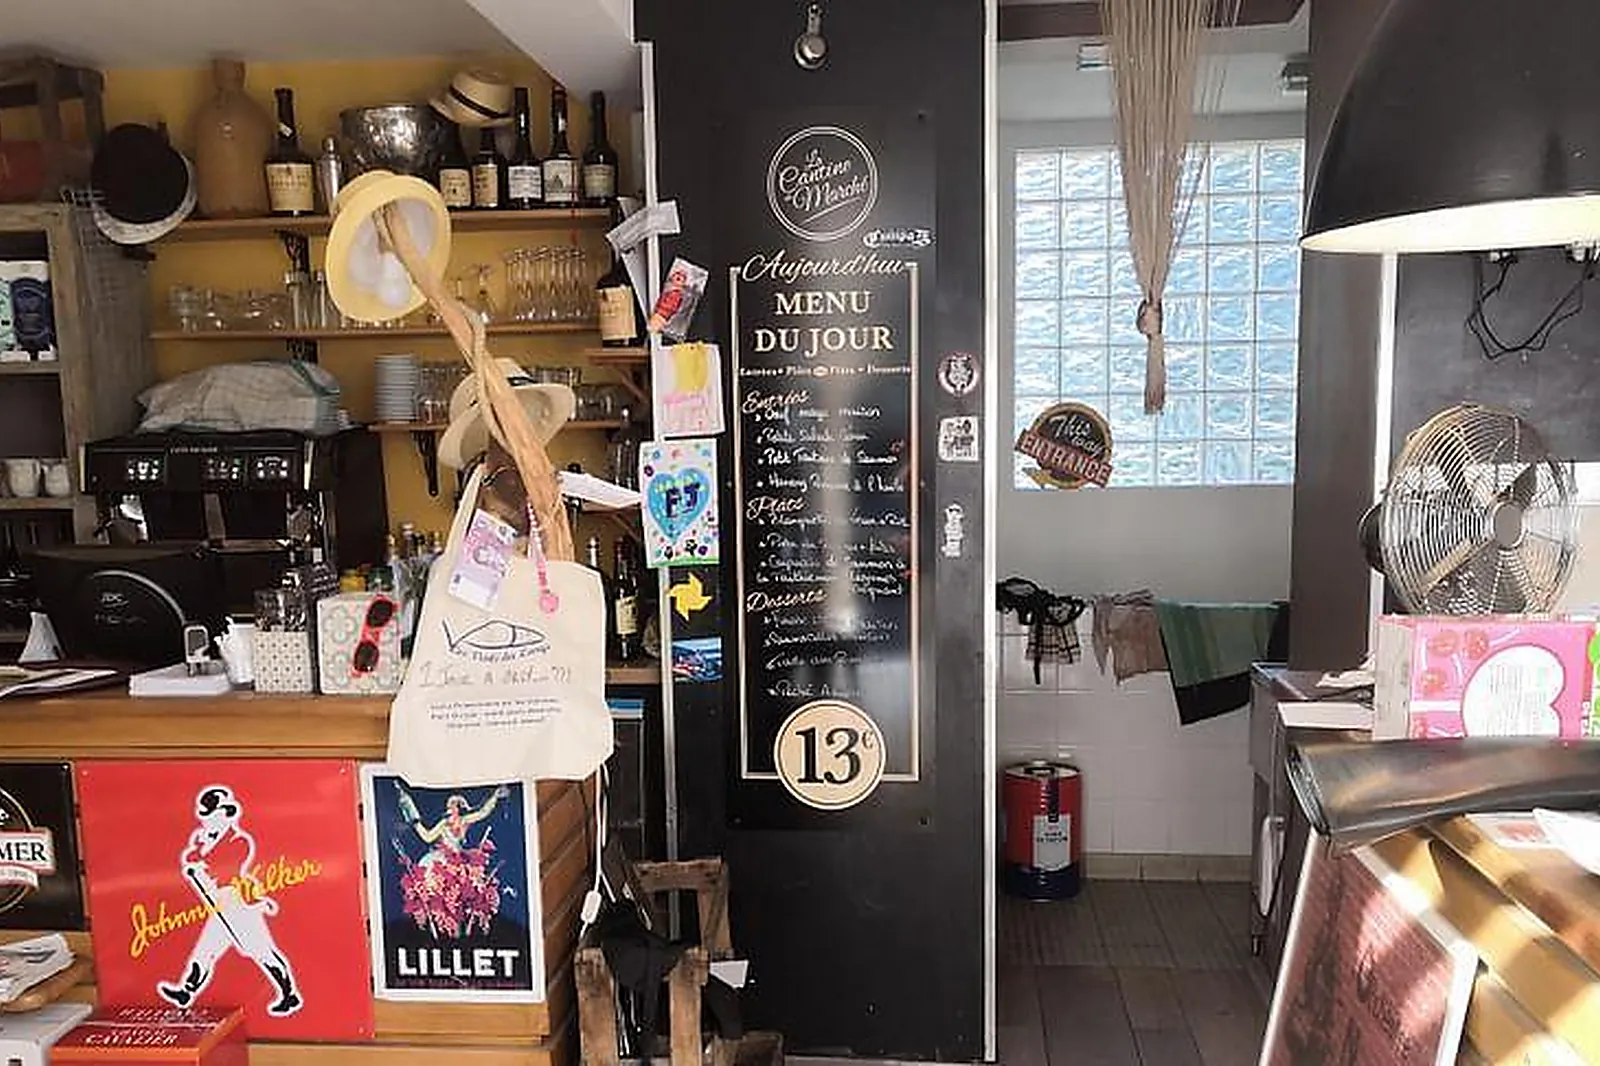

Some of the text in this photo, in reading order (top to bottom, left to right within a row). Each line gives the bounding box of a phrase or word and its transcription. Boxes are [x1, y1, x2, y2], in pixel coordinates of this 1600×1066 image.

[775, 291, 871, 315] MENU
[754, 326, 894, 358] DU JOUR
[1019, 430, 1111, 485] ENTRANCE
[397, 948, 519, 978] LILLET
